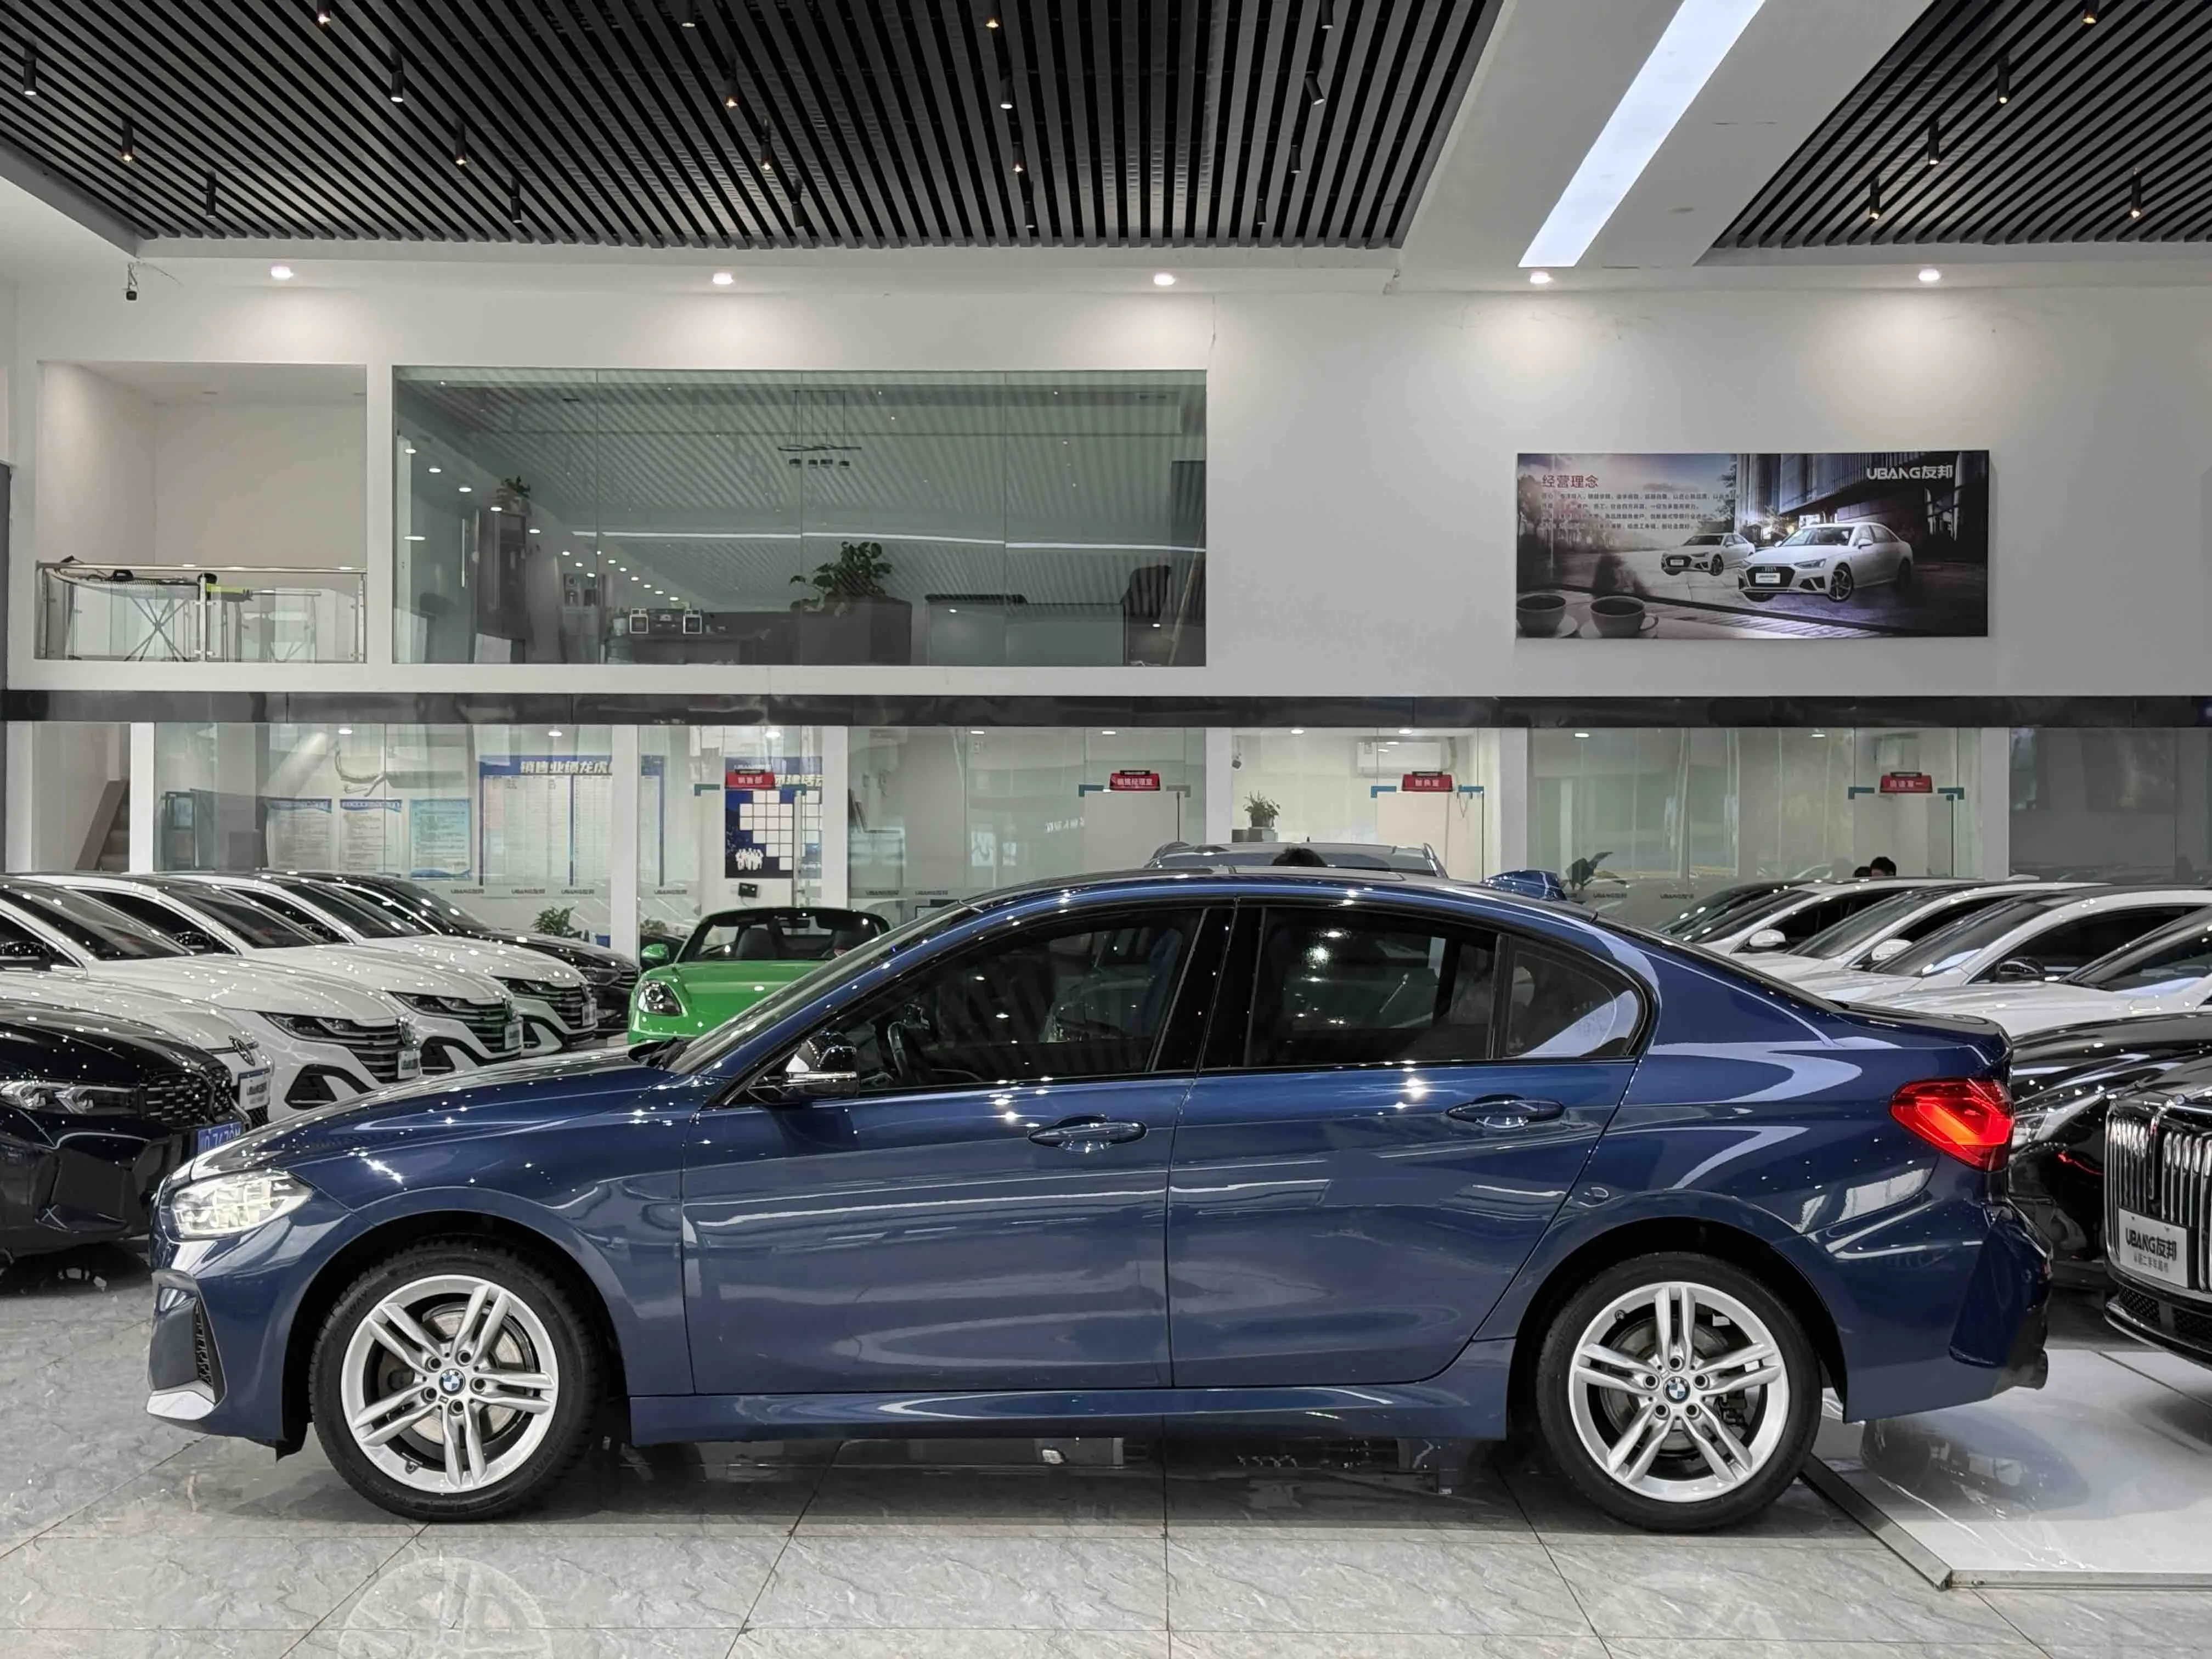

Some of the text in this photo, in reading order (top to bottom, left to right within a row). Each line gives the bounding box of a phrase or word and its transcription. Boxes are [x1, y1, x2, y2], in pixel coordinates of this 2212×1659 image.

[1866, 465, 1953, 480] UBANG友邦
[1542, 475, 1599, 488] 经营理念
[521, 760, 612, 774] 销售业绩龙虎
[2125, 1228, 2177, 1261] UBANG友邦
